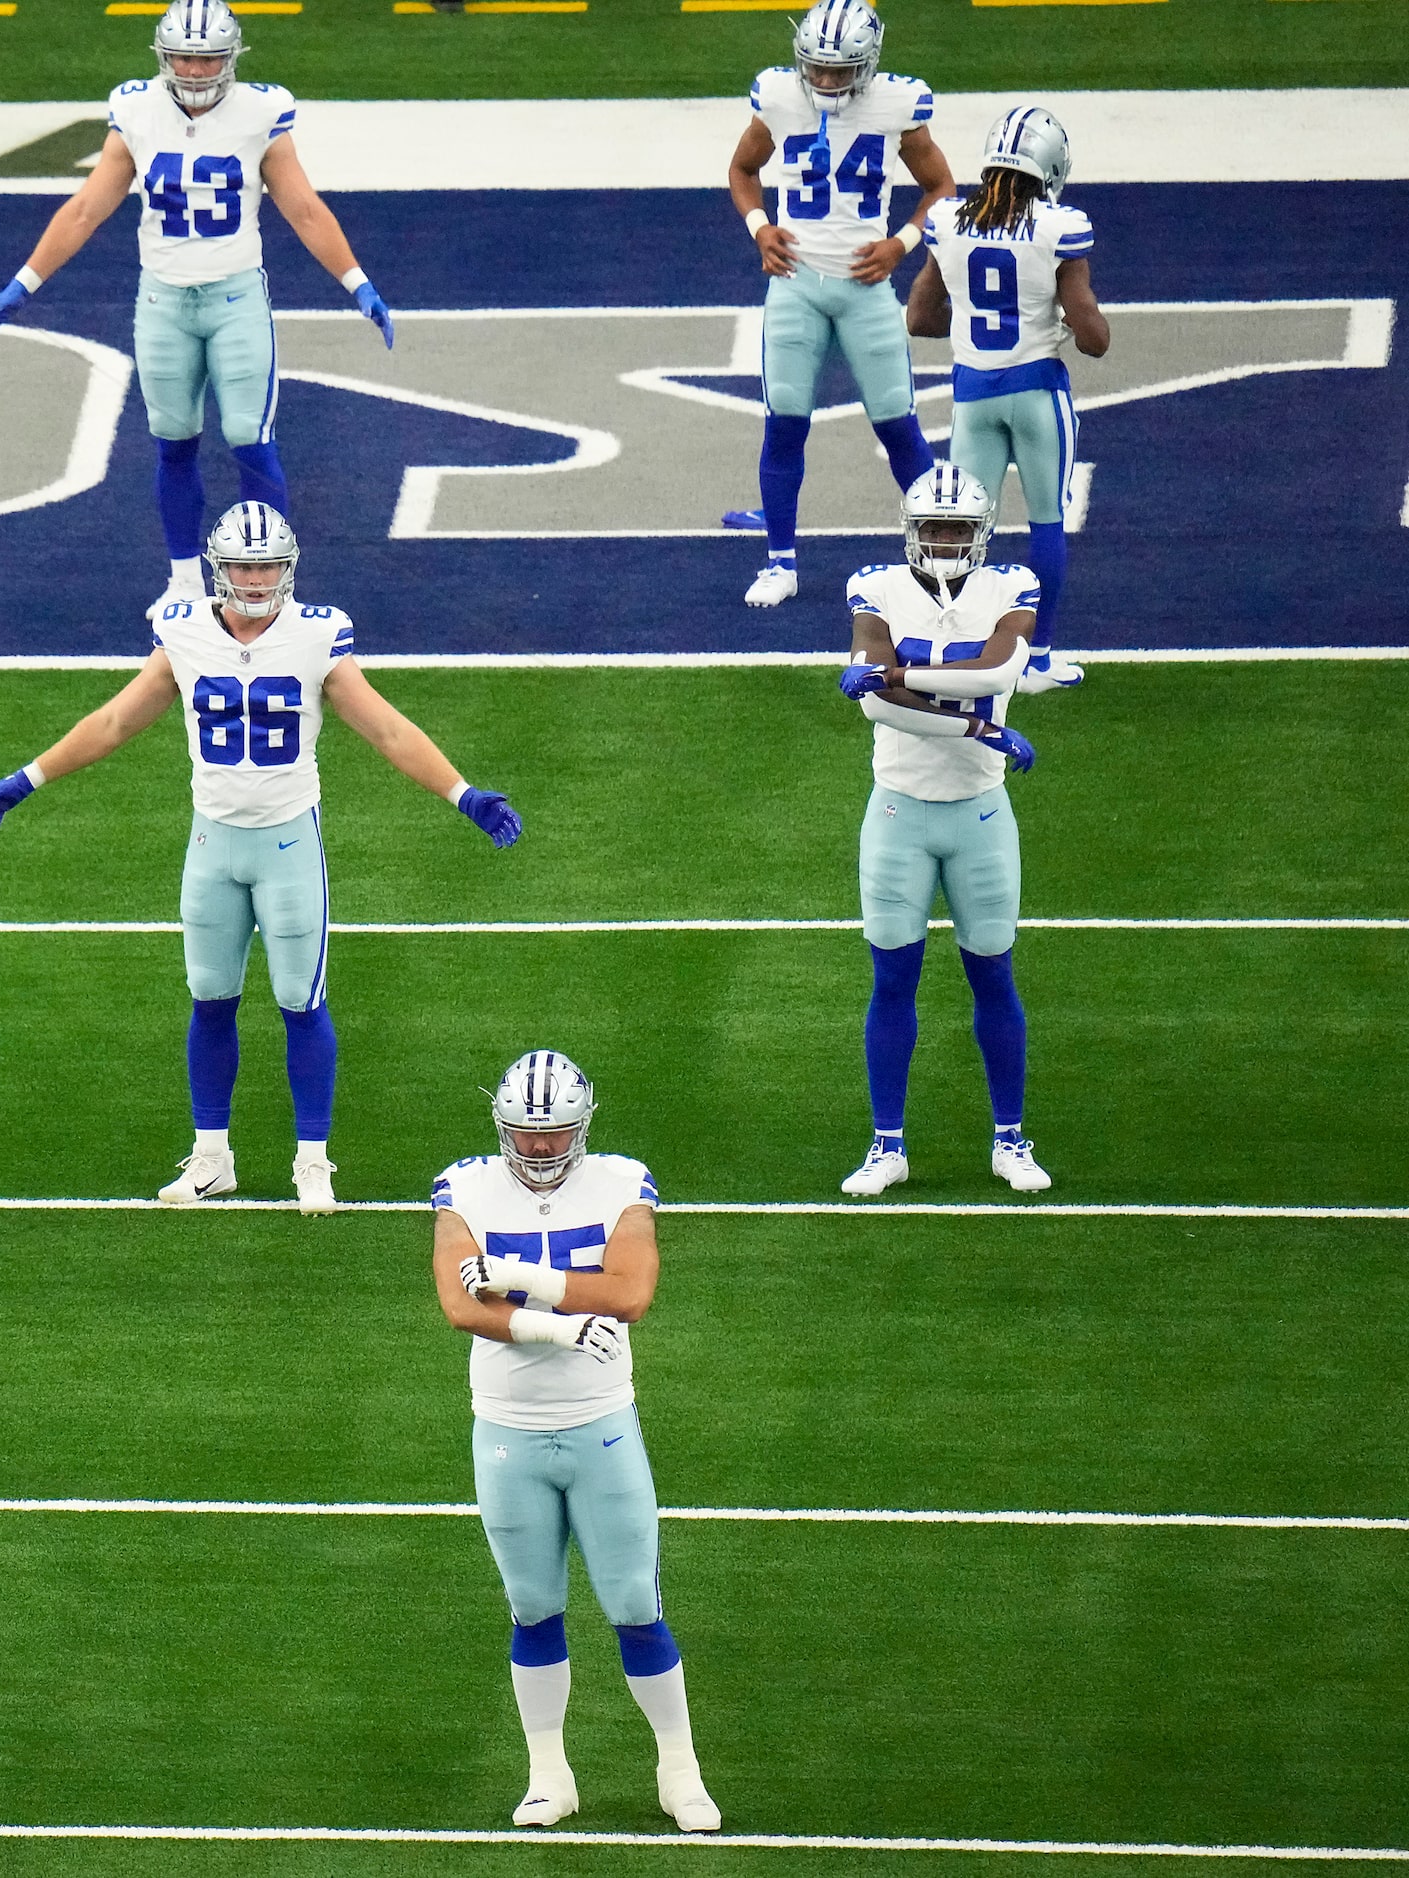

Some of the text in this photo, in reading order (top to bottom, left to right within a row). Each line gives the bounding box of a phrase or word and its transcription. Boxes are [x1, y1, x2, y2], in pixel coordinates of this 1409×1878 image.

[145, 152, 243, 238] 43
[783, 133, 885, 219] 34
[968, 247, 1019, 350] 9
[192, 675, 303, 766] 86
